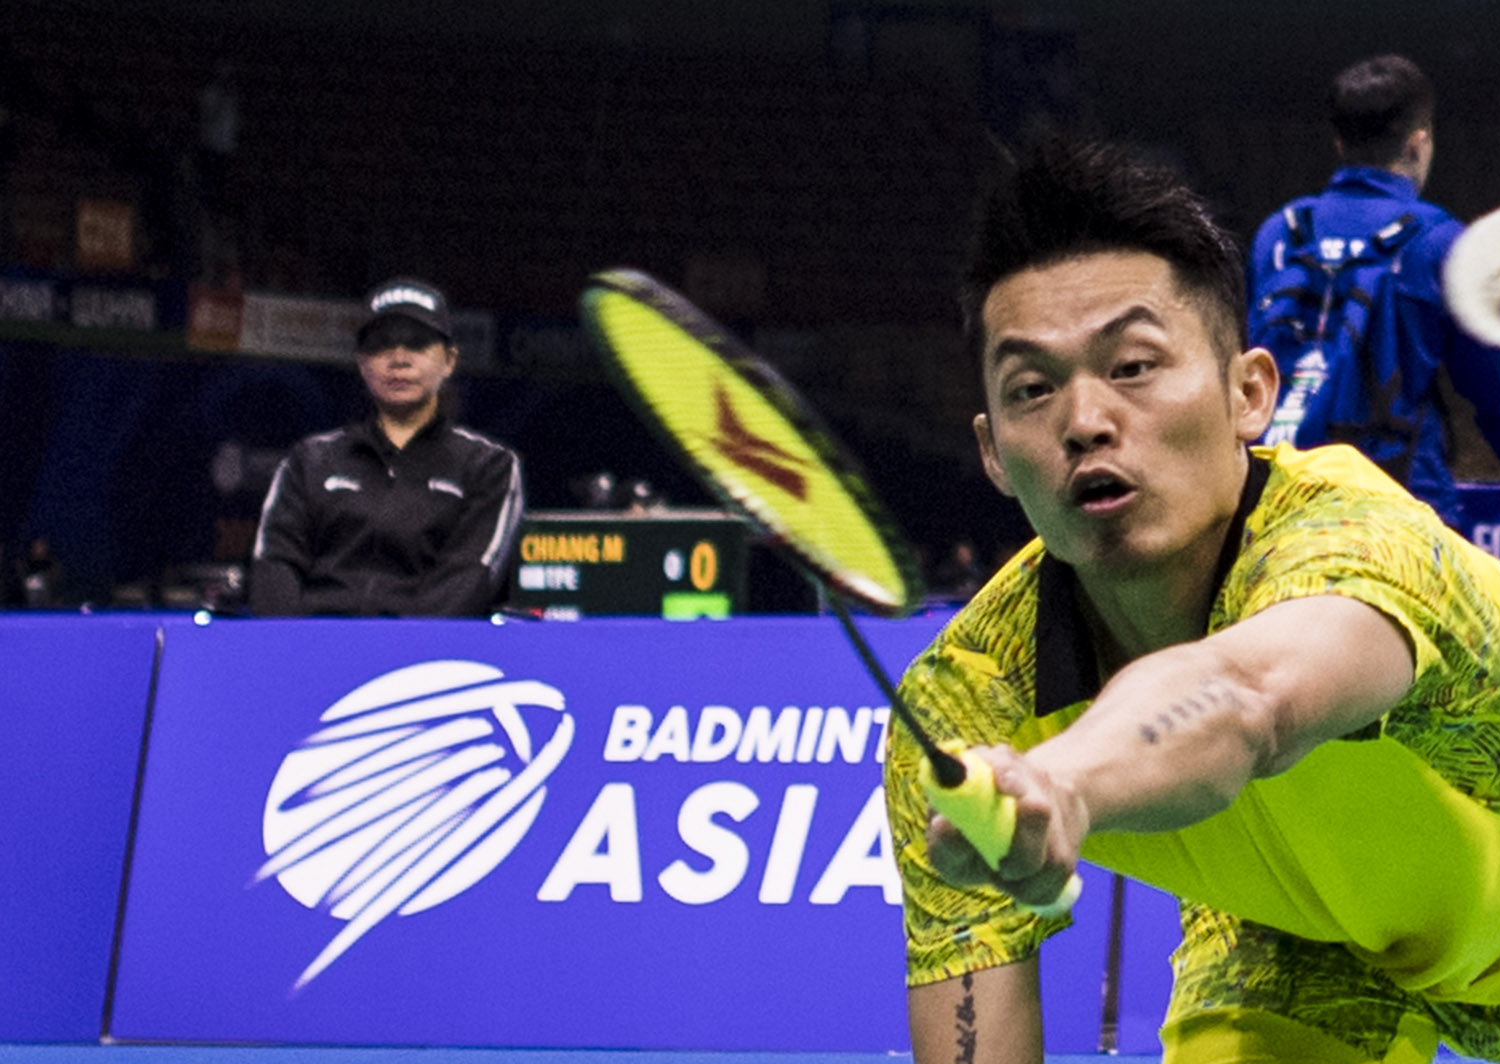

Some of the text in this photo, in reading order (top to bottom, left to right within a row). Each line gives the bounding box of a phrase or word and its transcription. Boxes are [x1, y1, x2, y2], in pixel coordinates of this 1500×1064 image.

[521, 534, 624, 563] CHIANG M
[690, 541, 717, 590] 0
[536, 780, 903, 905] ASIA
